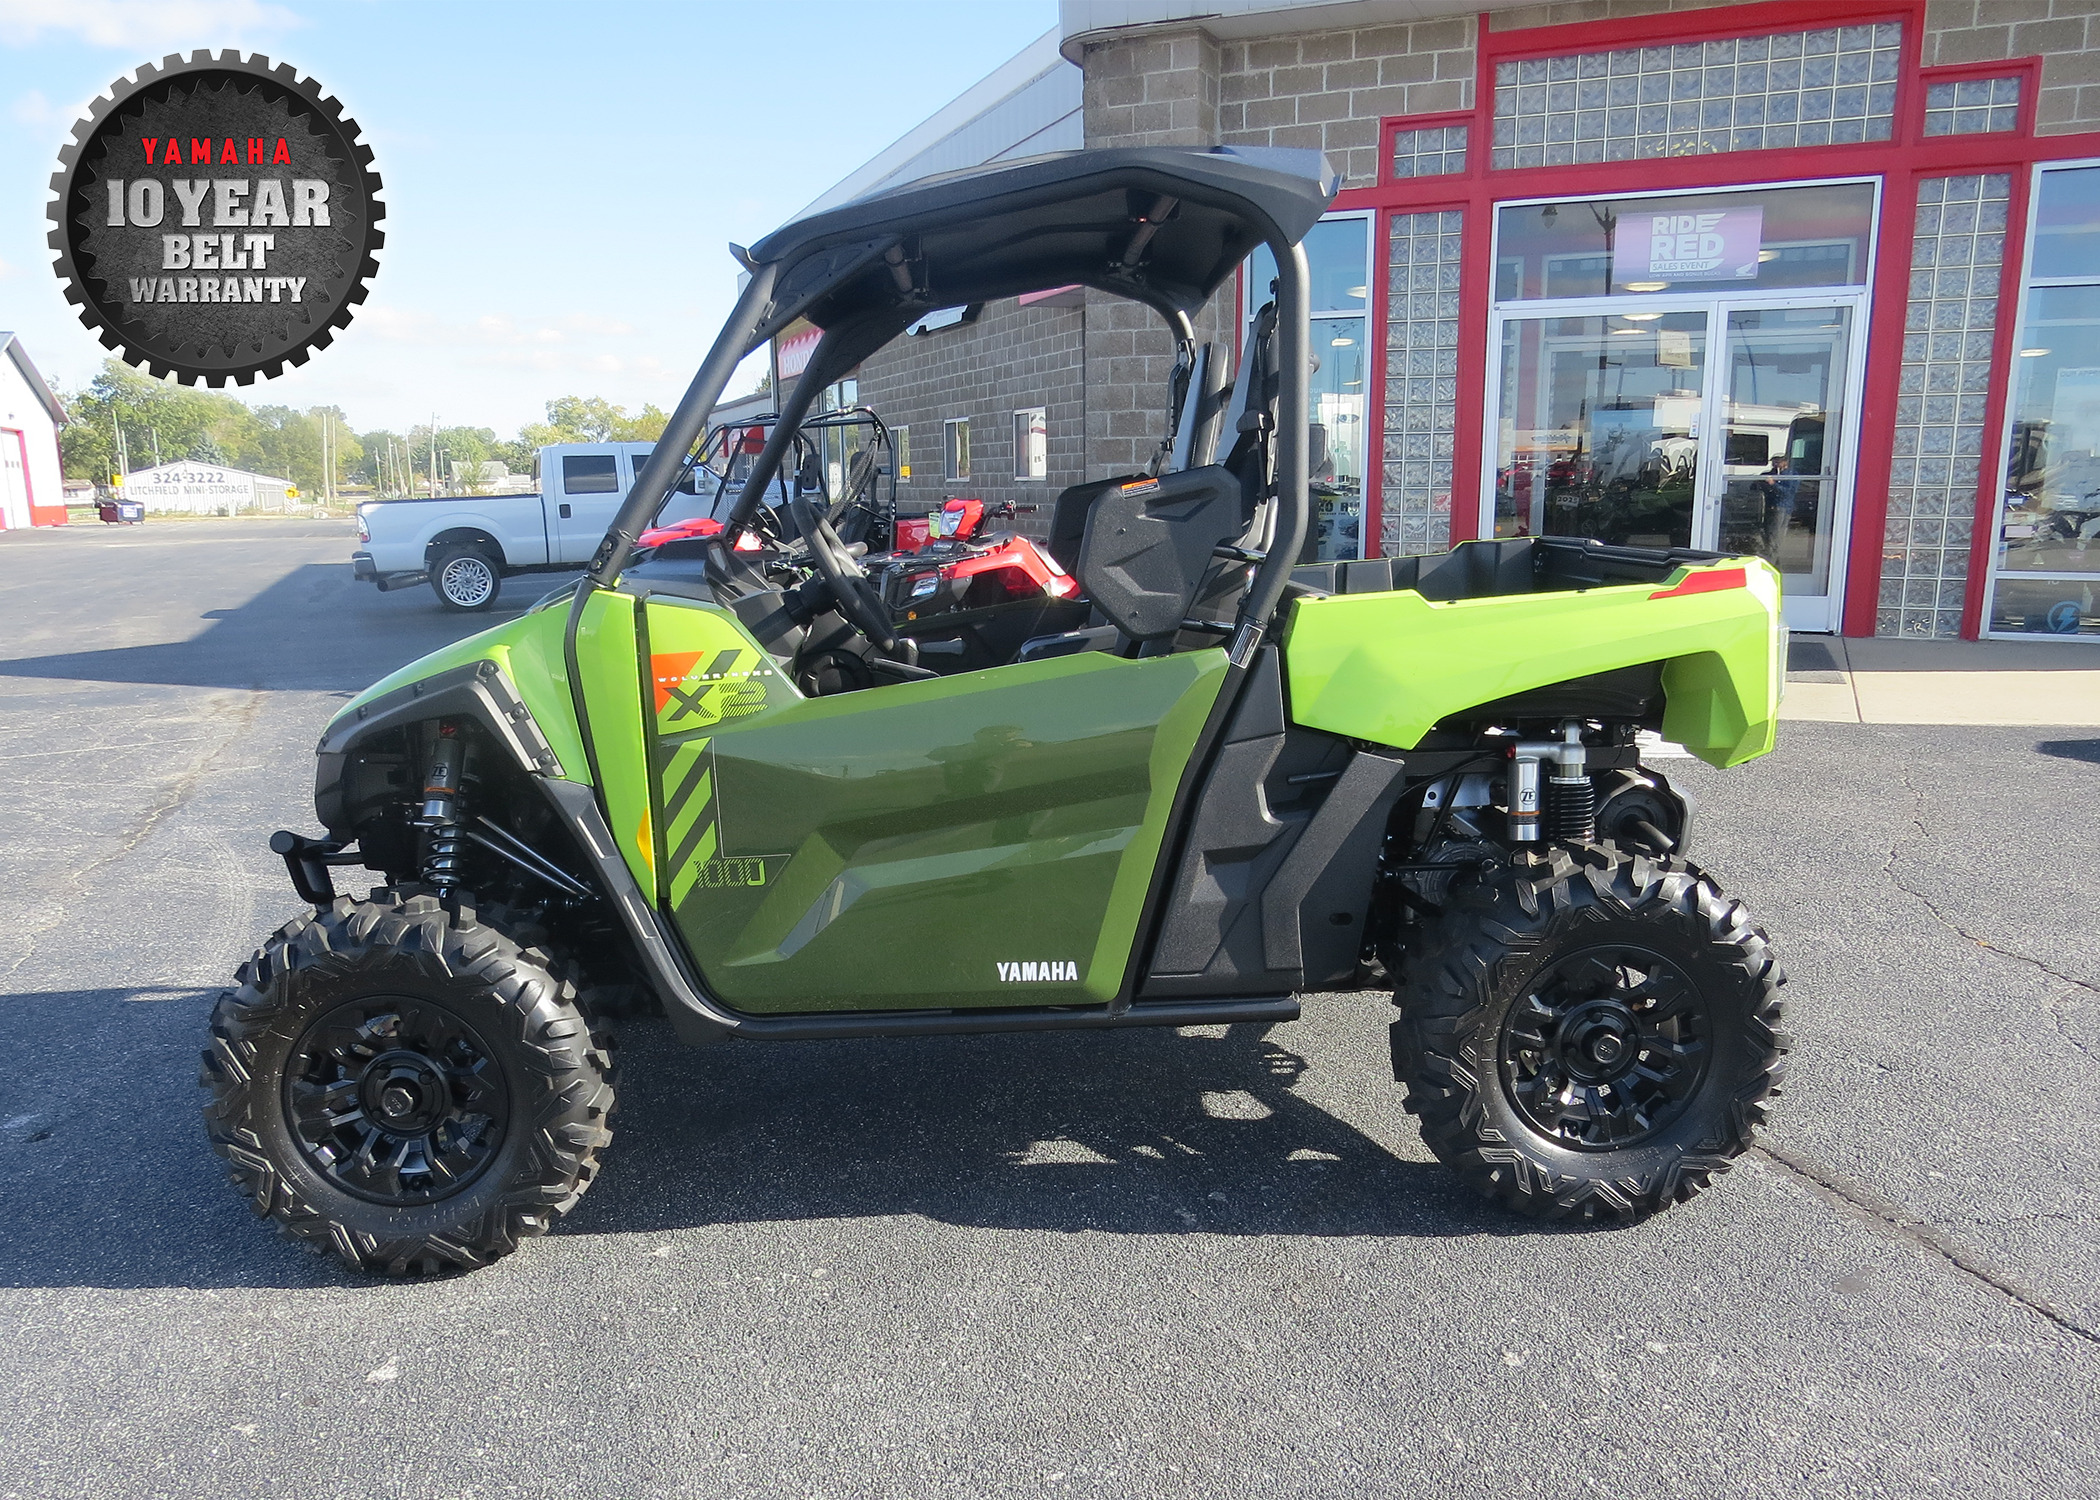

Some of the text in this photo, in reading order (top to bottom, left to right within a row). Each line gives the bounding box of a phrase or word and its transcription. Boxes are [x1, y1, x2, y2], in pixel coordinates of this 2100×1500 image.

[1652, 213, 1726, 235] RIDE
[1650, 233, 1725, 260] RED
[1652, 261, 1709, 271] SALES EVENT
[784, 349, 813, 374] HOND
[153, 472, 225, 484] 324-3222
[130, 484, 249, 496] LITCHFIELD MINI-STORAGE
[1520, 791, 1536, 802] ZF
[693, 858, 766, 888] 1000
[996, 961, 1078, 982] YAMAHA
